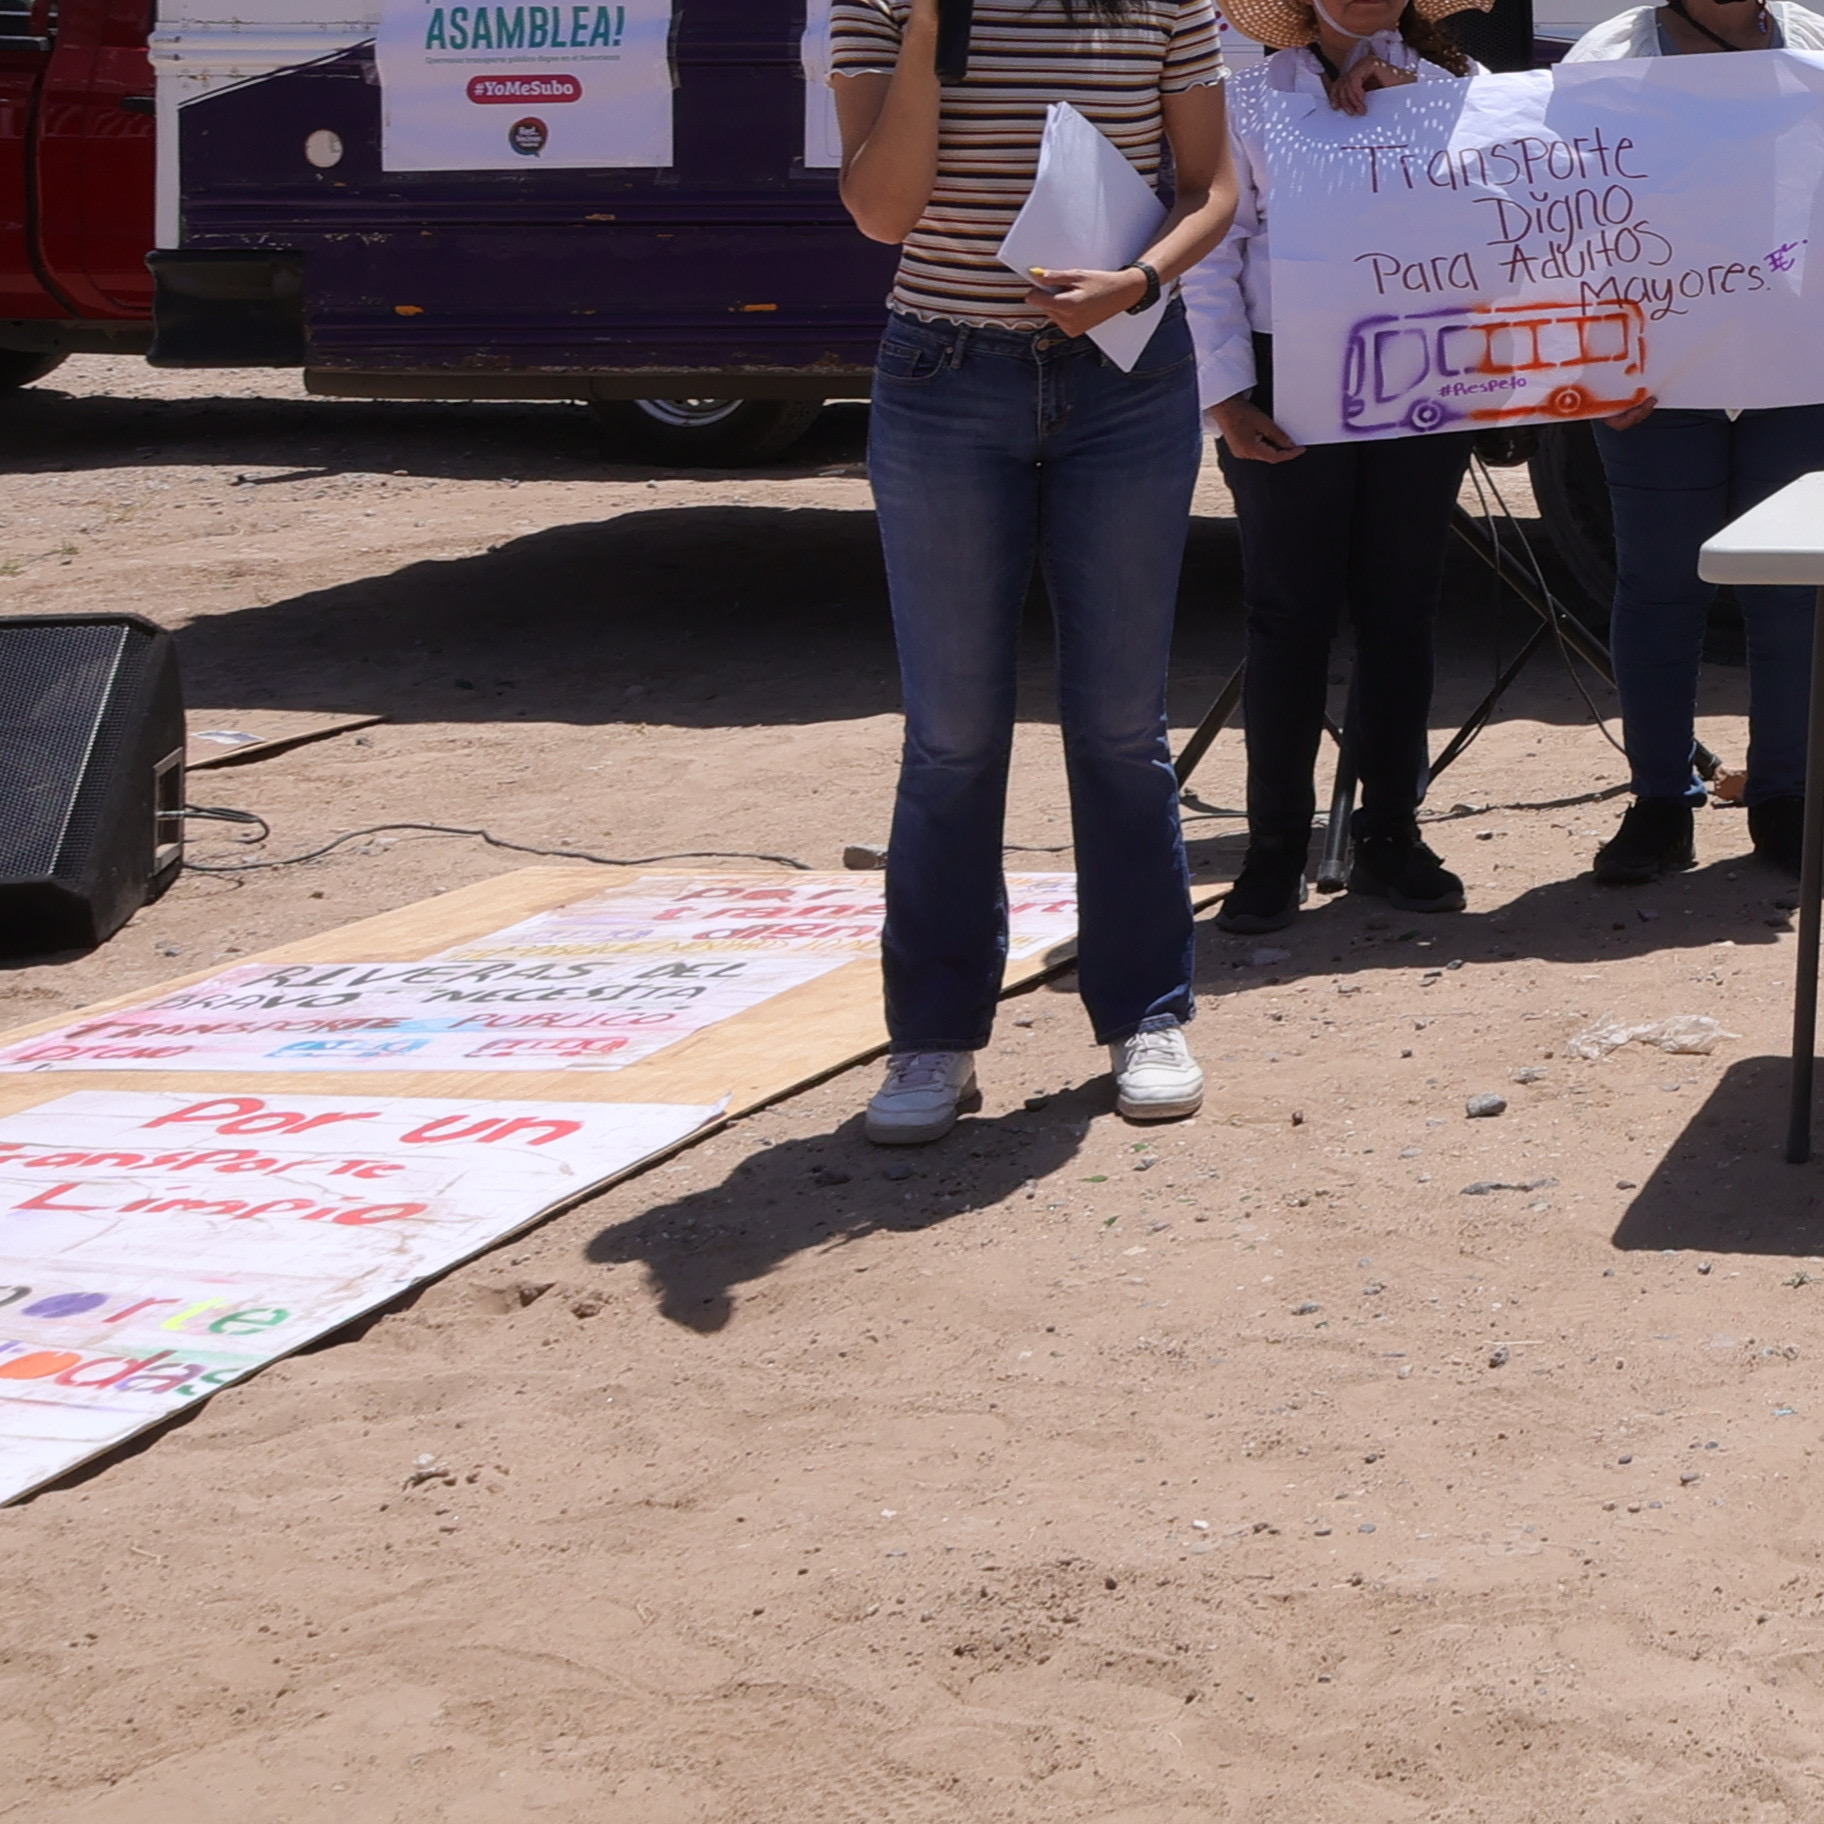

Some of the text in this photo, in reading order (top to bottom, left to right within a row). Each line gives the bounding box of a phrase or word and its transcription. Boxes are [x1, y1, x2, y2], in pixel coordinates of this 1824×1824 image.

[425, 5, 626, 51] ASAMBLEA!
[473, 80, 575, 97] #YoMeSubo
[1472, 183, 1634, 253] Digno
[1352, 220, 1674, 294] Para Adultos
[1580, 261, 1772, 322] Mayores.
[239, 959, 749, 988] RIVERAS DEL
[146, 984, 708, 1012] BRAVO NECESITA
[64, 1012, 680, 1040] TRANSPORTE PUBLICO
[17, 1044, 196, 1062] DIGNO
[139, 1096, 585, 1146] Por un
[10, 1180, 431, 1226] Limpio
